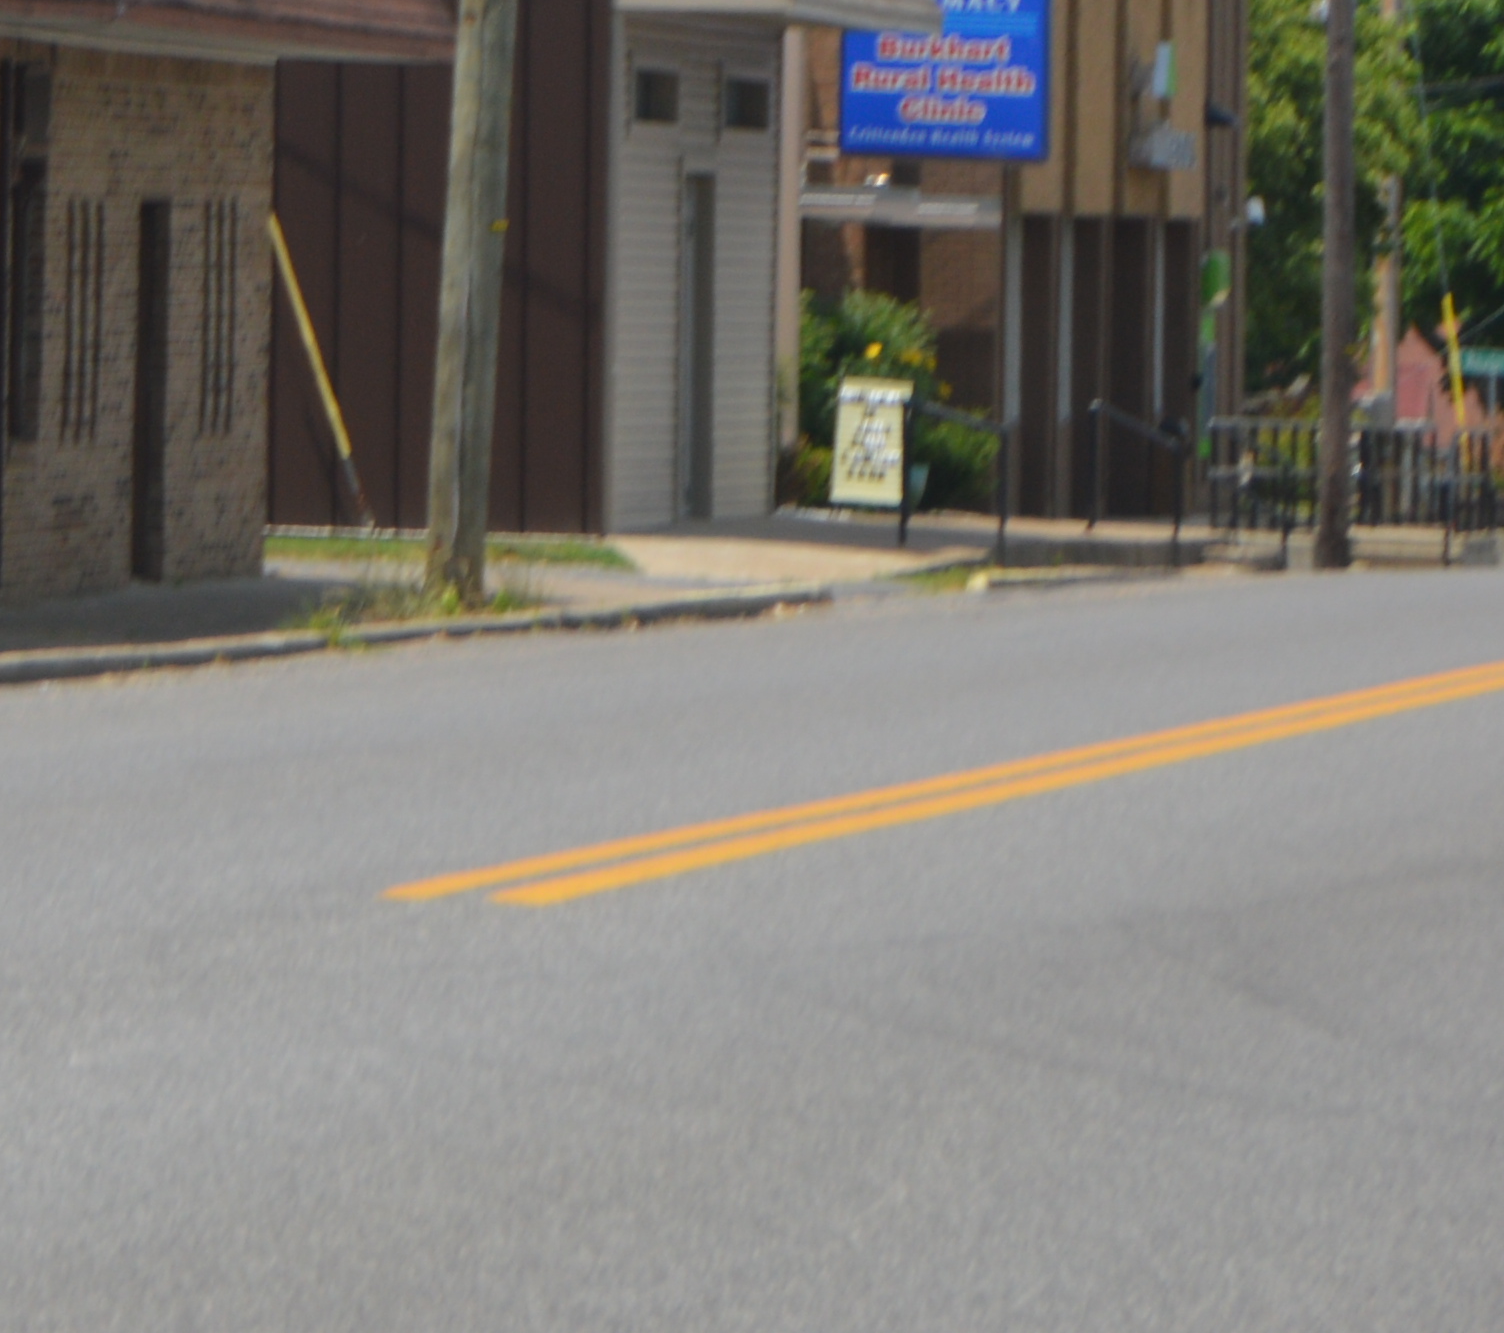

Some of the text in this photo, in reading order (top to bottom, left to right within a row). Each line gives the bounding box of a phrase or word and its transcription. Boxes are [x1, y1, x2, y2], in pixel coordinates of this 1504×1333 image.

[876, 33, 1012, 63] Burkhart
[851, 61, 1037, 97] Rural Health
[897, 94, 987, 126] Clinic
